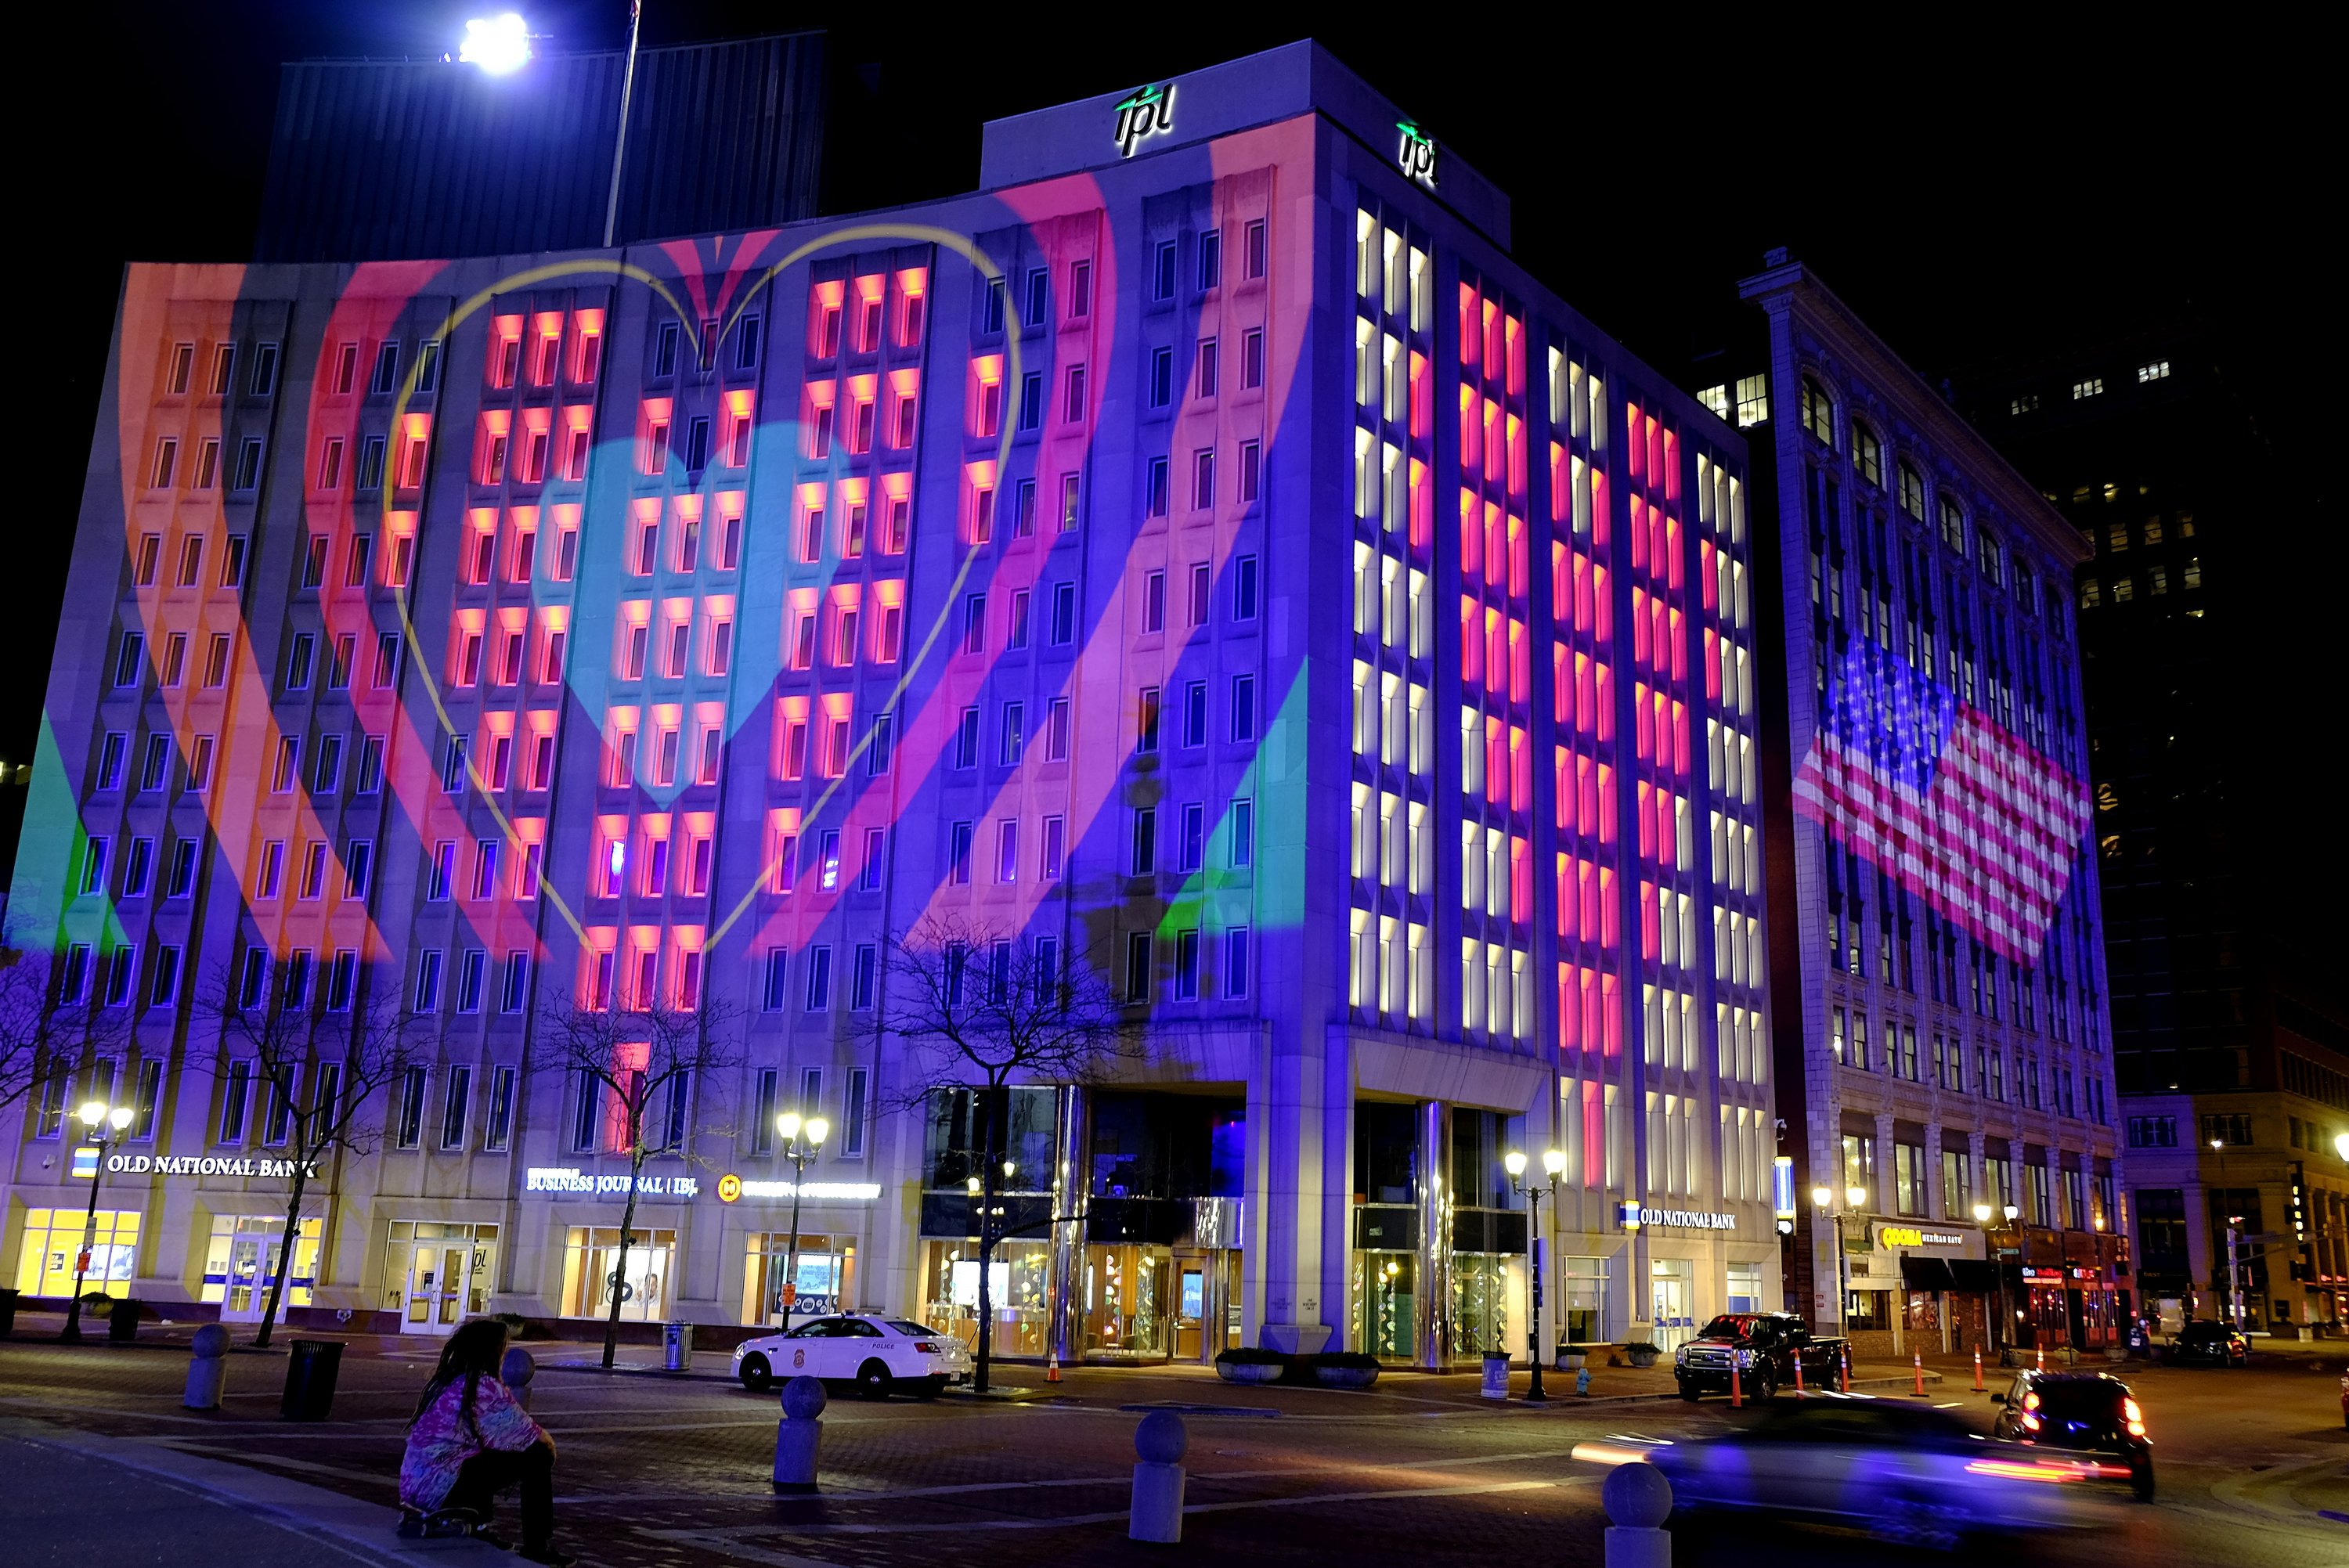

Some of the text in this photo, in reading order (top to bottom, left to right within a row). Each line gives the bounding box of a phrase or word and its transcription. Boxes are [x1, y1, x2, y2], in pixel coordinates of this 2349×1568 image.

[106, 1155, 316, 1178] OLD NATIONAL BANK
[526, 1175, 594, 1191] BUSINESS
[595, 1176, 664, 1195] JOURNAL
[1640, 1208, 1736, 1229] OLD NATIONAL BANK
[1880, 1227, 1923, 1251] QDOBA
